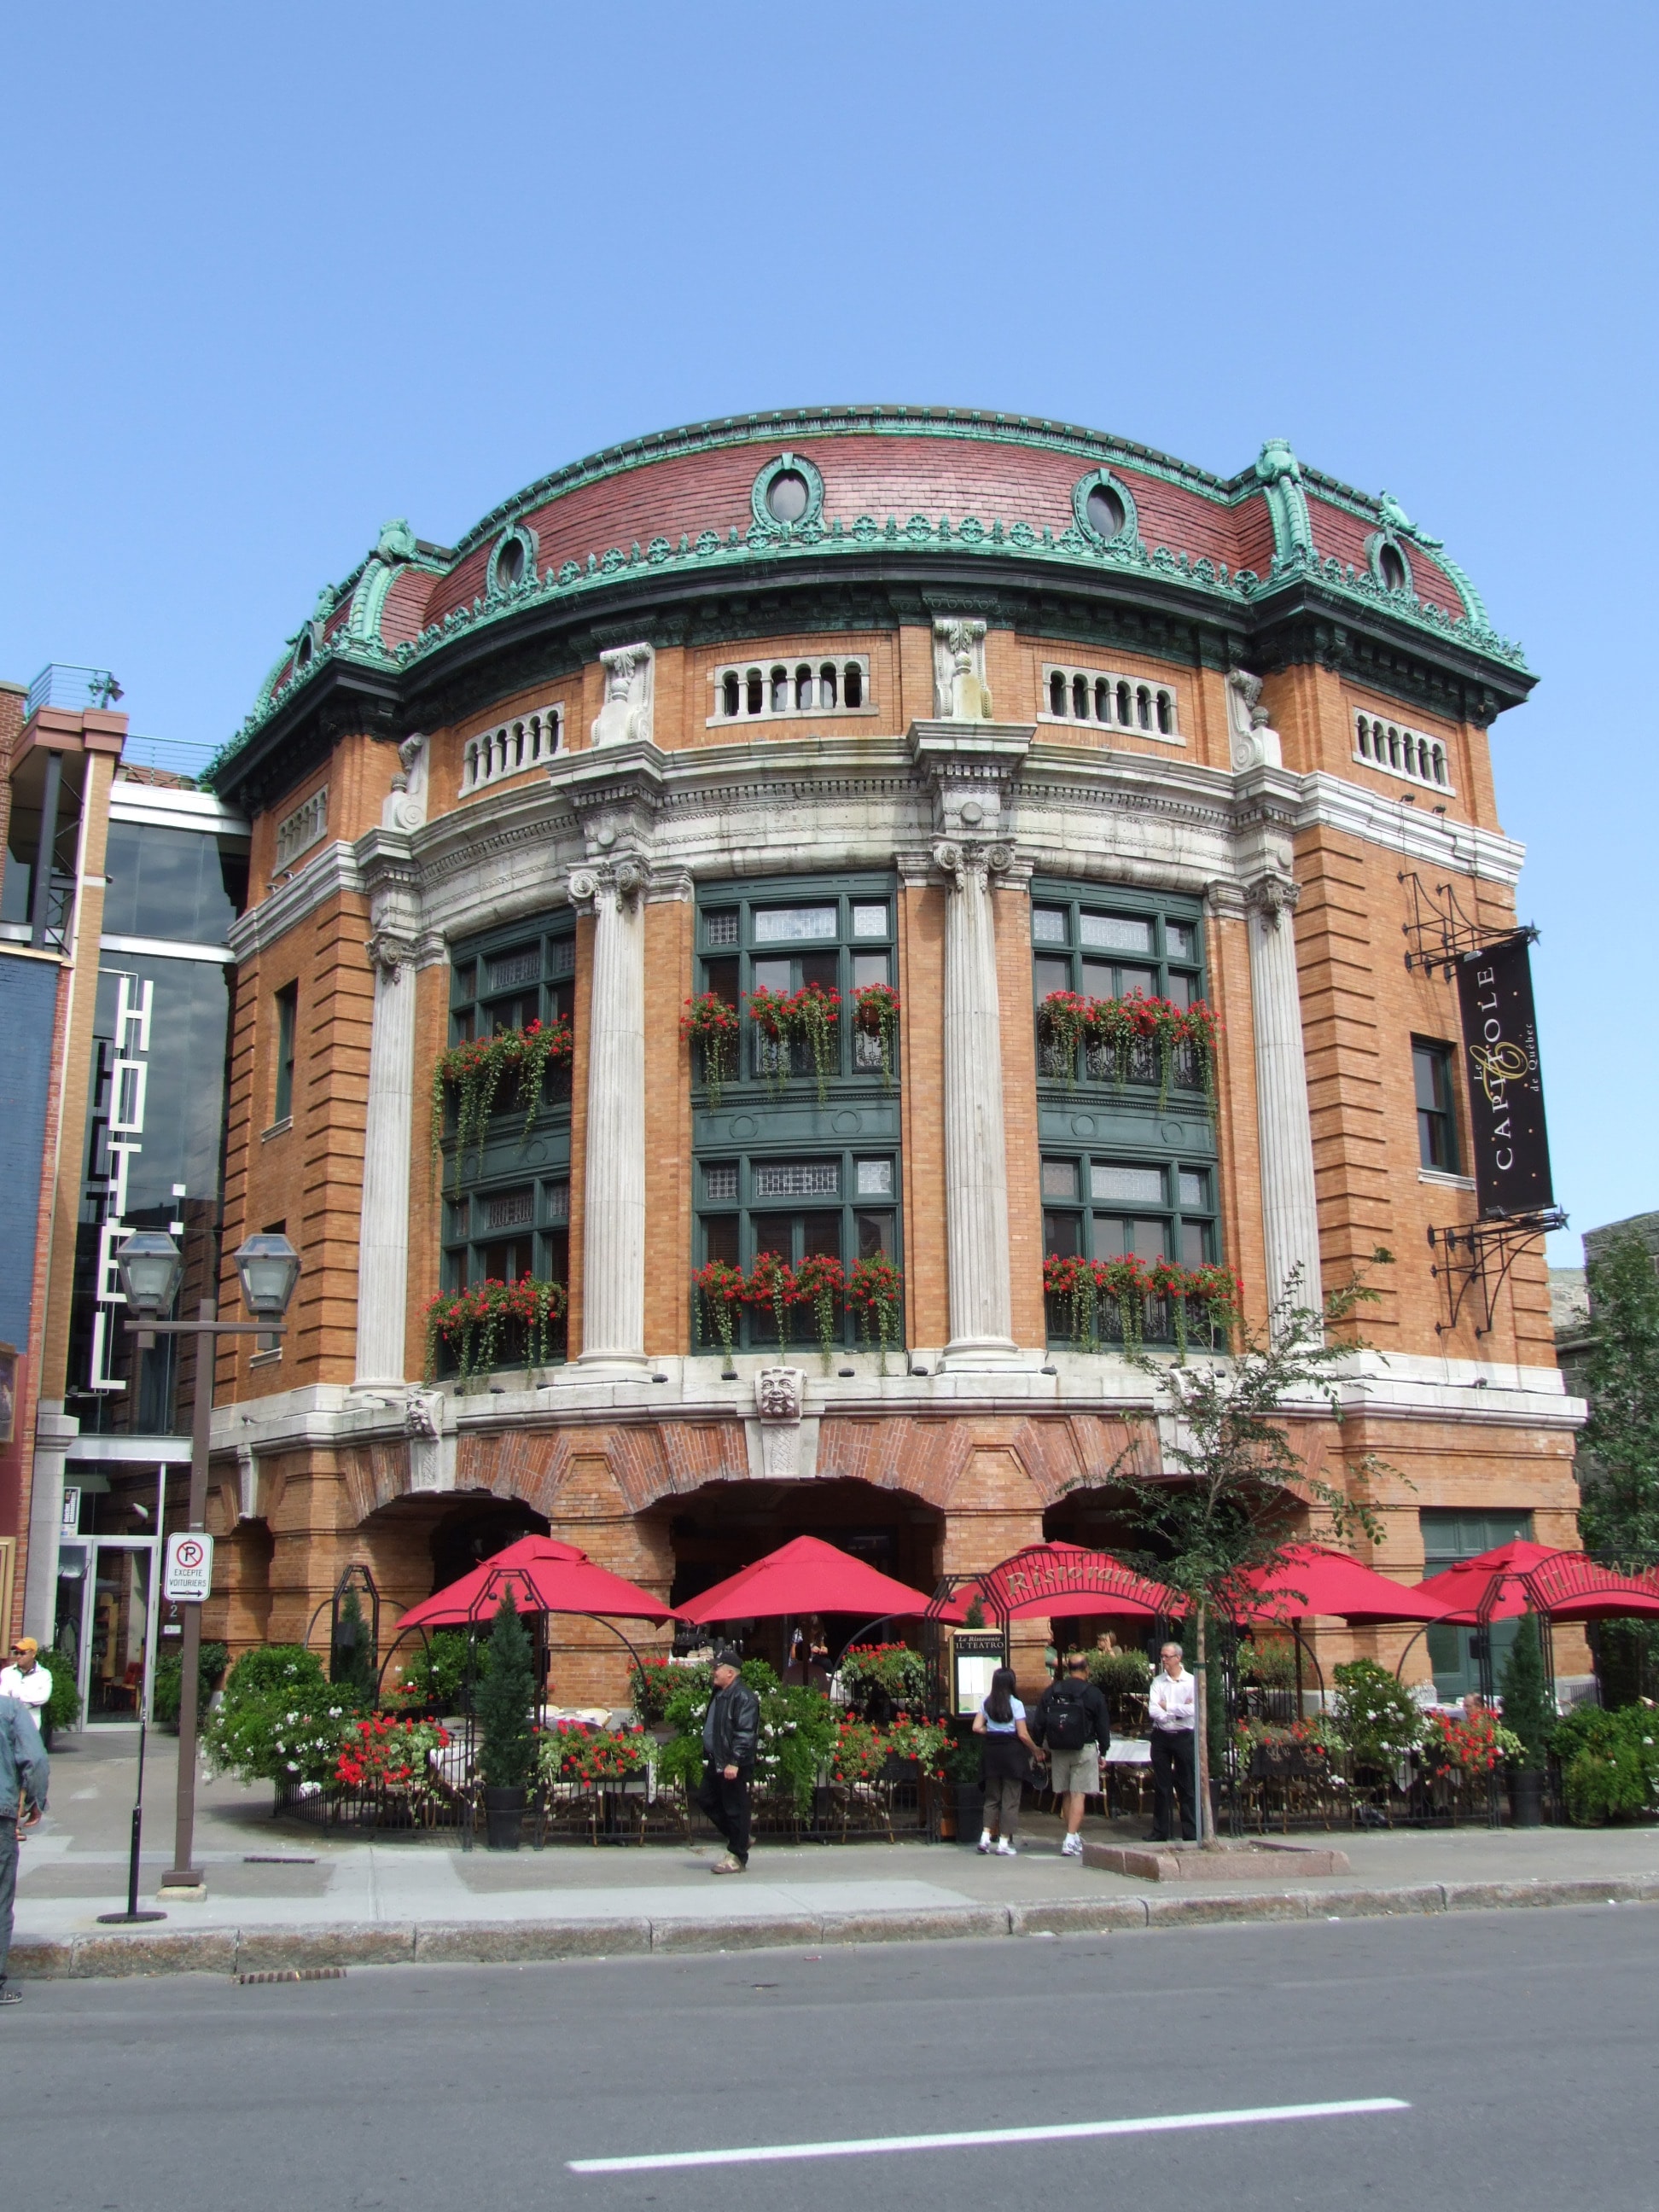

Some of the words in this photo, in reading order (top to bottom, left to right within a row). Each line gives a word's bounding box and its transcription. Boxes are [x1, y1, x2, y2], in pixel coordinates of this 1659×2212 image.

[1525, 1023, 1539, 1071] Québec
[1474, 1064, 1483, 1080] Le
[1477, 966, 1513, 1171] CAPITOLE
[1530, 1078, 1540, 1092] de
[90, 977, 154, 1389] HOTEL
[169, 1579, 207, 1587] VOITURIERS
[1005, 1564, 1156, 1597] Ristorante
[1541, 1570, 1570, 1594] IL
